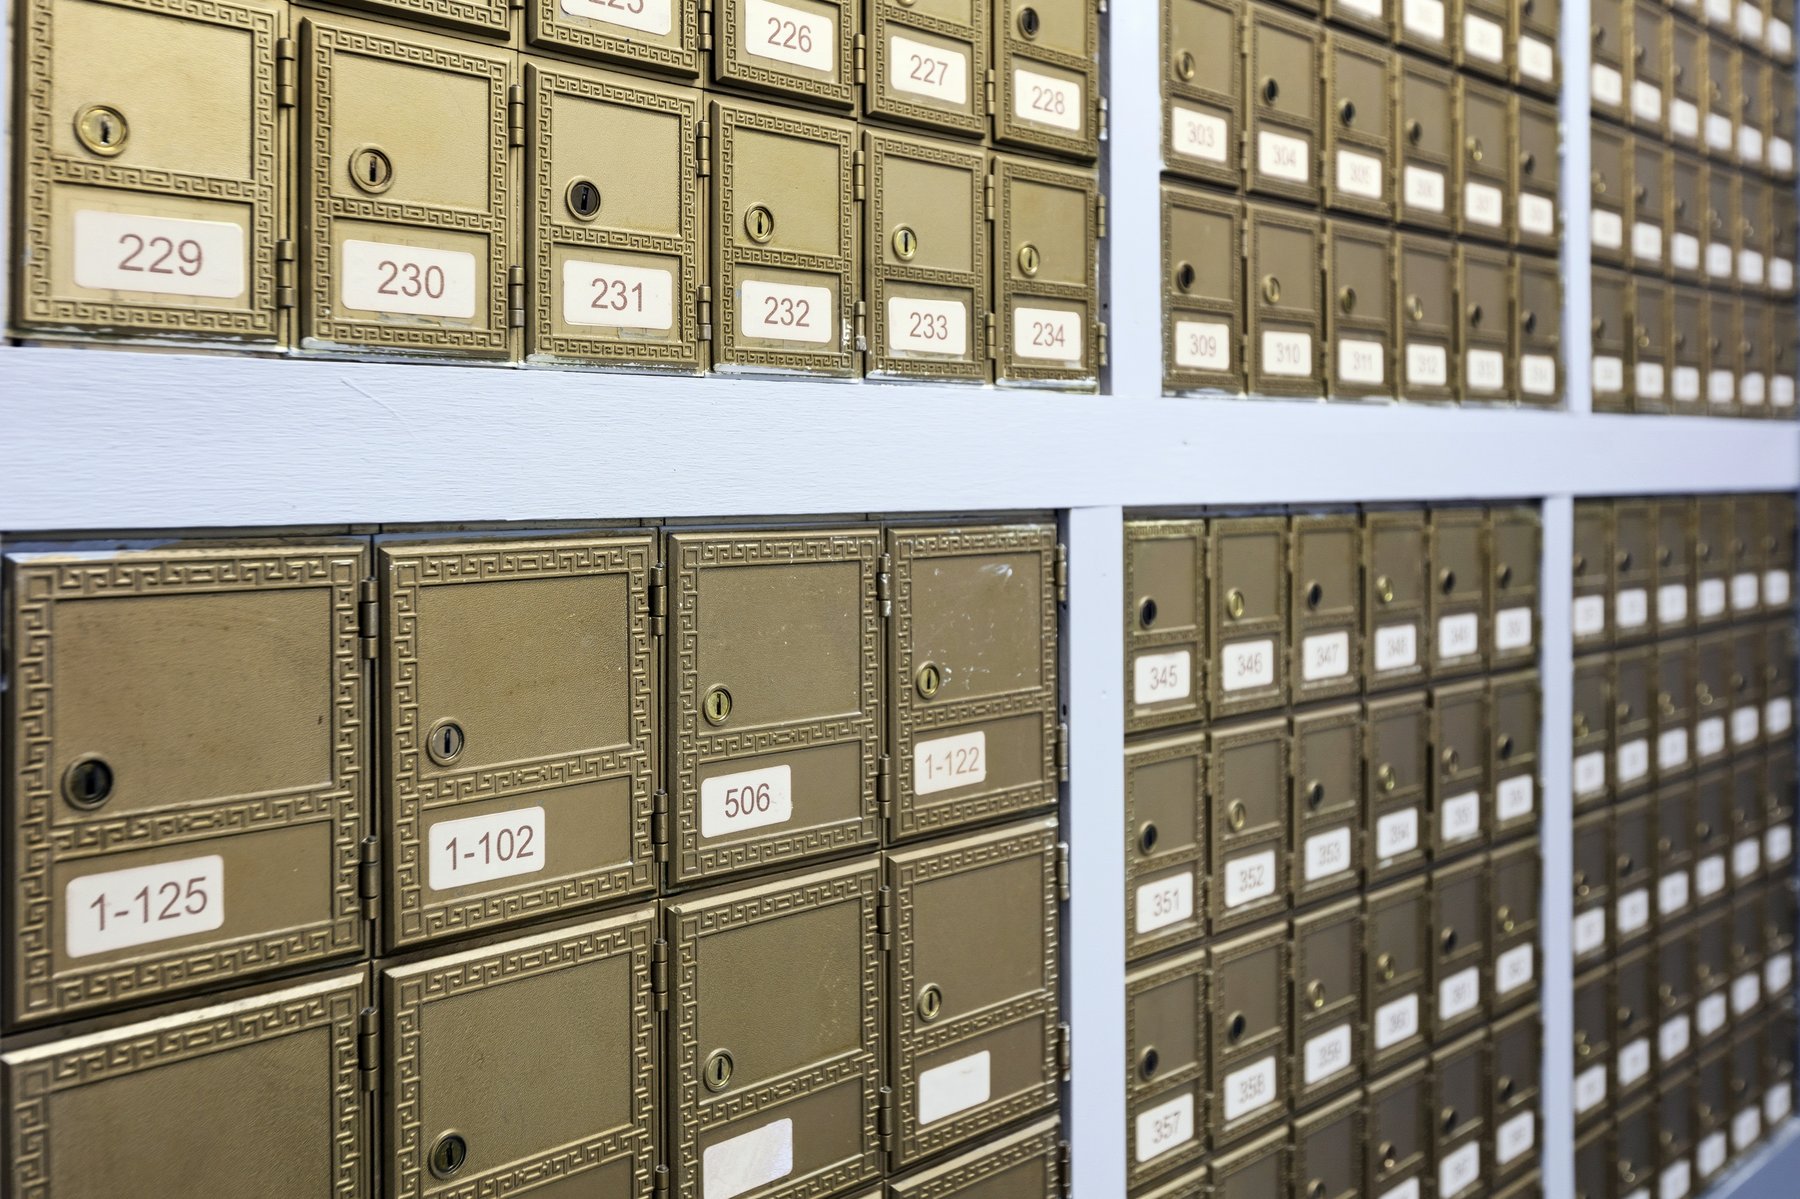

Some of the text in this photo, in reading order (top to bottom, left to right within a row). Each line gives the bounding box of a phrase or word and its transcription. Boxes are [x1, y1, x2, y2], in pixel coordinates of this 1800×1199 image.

[767, 17, 812, 54] 226
[910, 55, 948, 86] 227
[1032, 86, 1065, 115] 228
[1188, 121, 1215, 148] 303
[1273, 144, 1297, 167] 304
[118, 233, 204, 277] 229
[376, 260, 445, 299] 230
[591, 278, 643, 312] 231
[764, 296, 810, 327] 232
[910, 312, 948, 340] 233
[1032, 322, 1065, 348] 234
[1190, 334, 1217, 357] 309
[1276, 342, 1301, 365] 310
[1237, 652, 1262, 676] 346
[1316, 643, 1339, 667] 347
[1150, 664, 1178, 691] 345
[925, 746, 980, 779] 1-122
[725, 783, 771, 818] 506
[445, 825, 533, 870] 1-102
[1239, 865, 1264, 892] 352
[90, 876, 208, 931] 1-125
[1153, 889, 1179, 917] 351
[1153, 1111, 1181, 1143] 357
